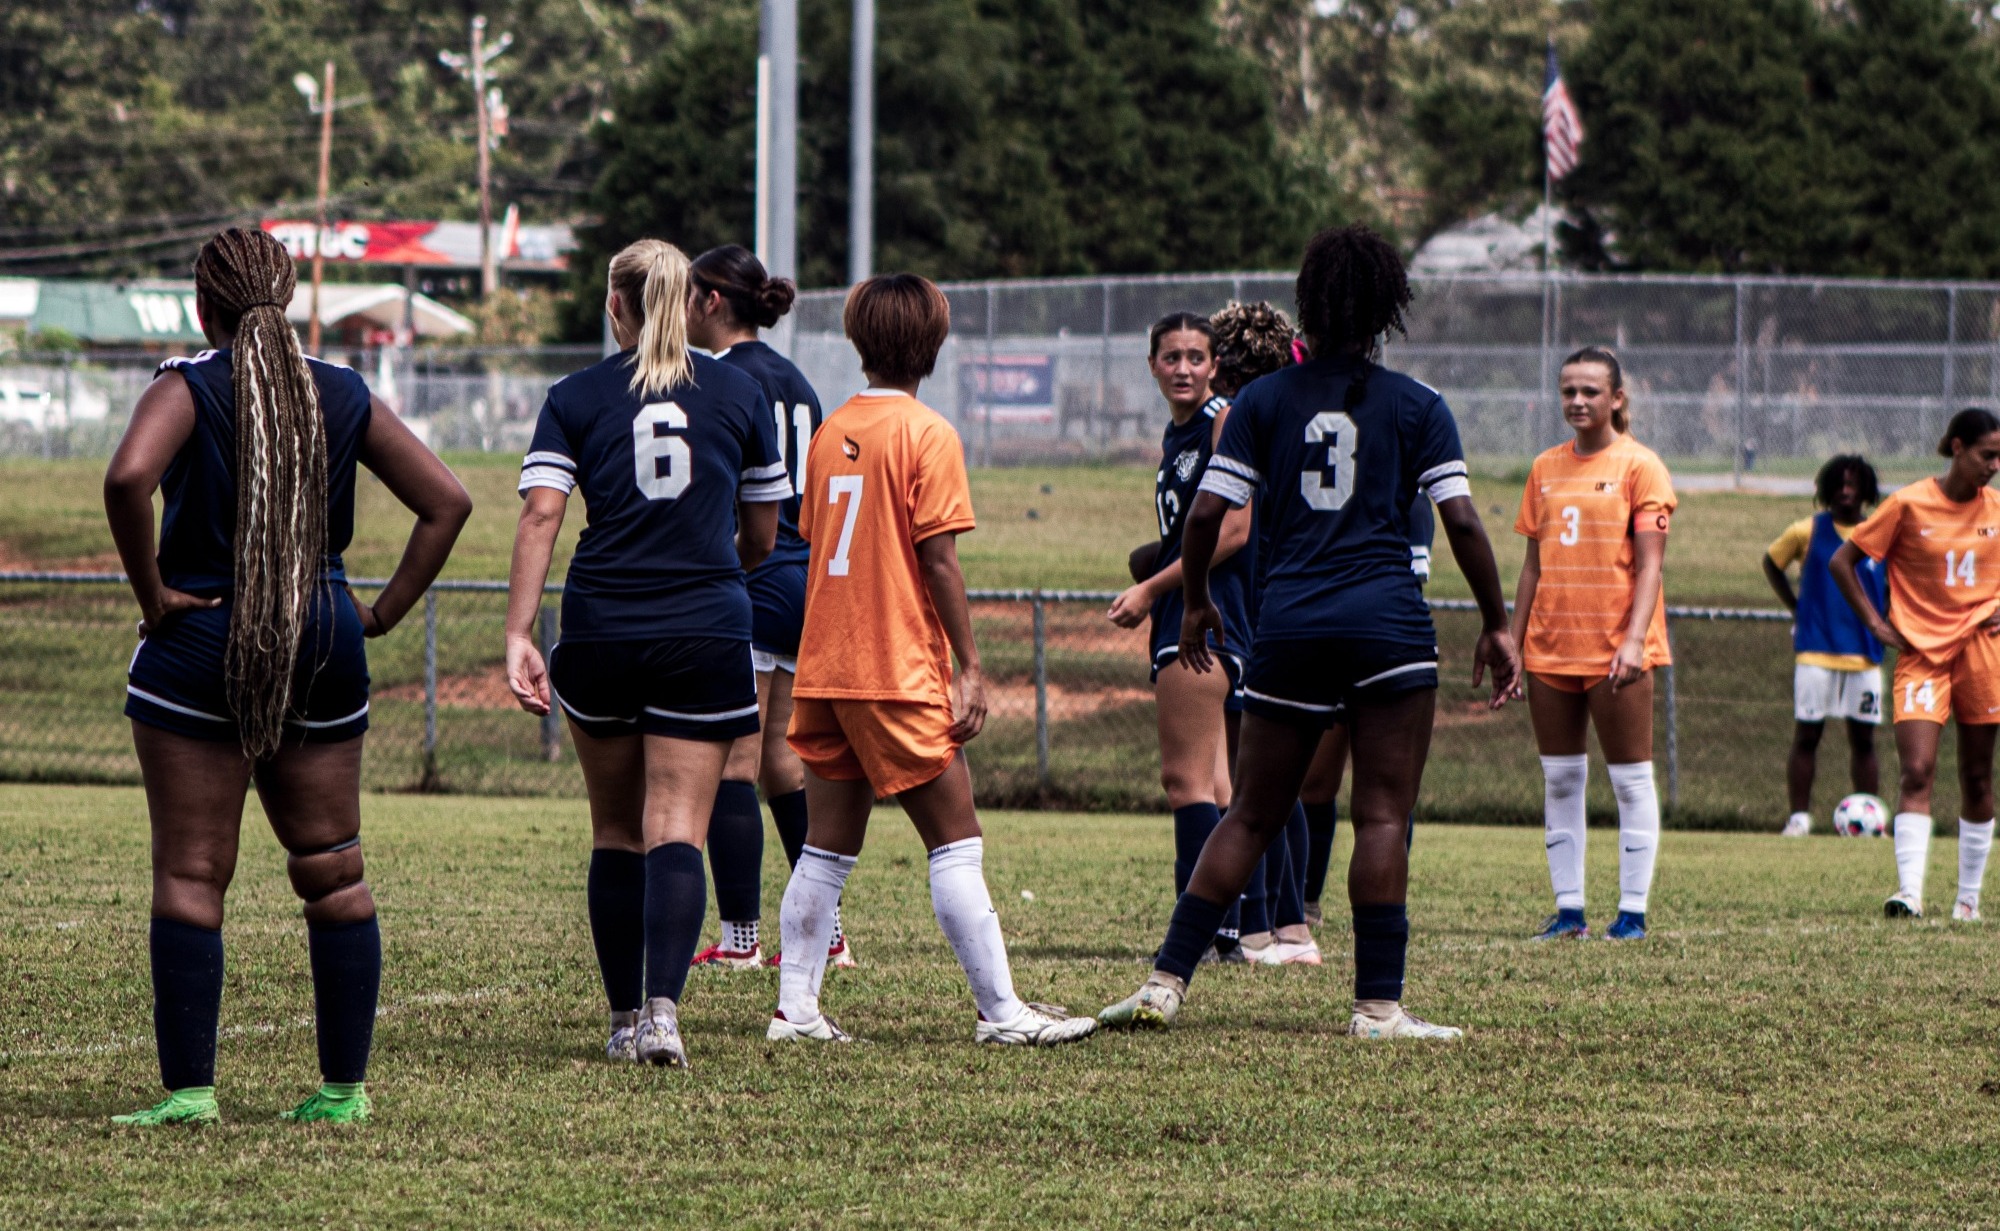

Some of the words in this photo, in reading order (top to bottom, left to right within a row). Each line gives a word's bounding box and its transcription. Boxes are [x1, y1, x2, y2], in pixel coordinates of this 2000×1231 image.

[633, 401, 692, 500] 6
[774, 401, 812, 494] 11
[1301, 411, 1358, 510] 3
[828, 475, 864, 575] 7
[1560, 505, 1580, 546] 3
[1656, 515, 1667, 530] C
[1945, 549, 1975, 587] 14
[1903, 679, 1934, 713] 14
